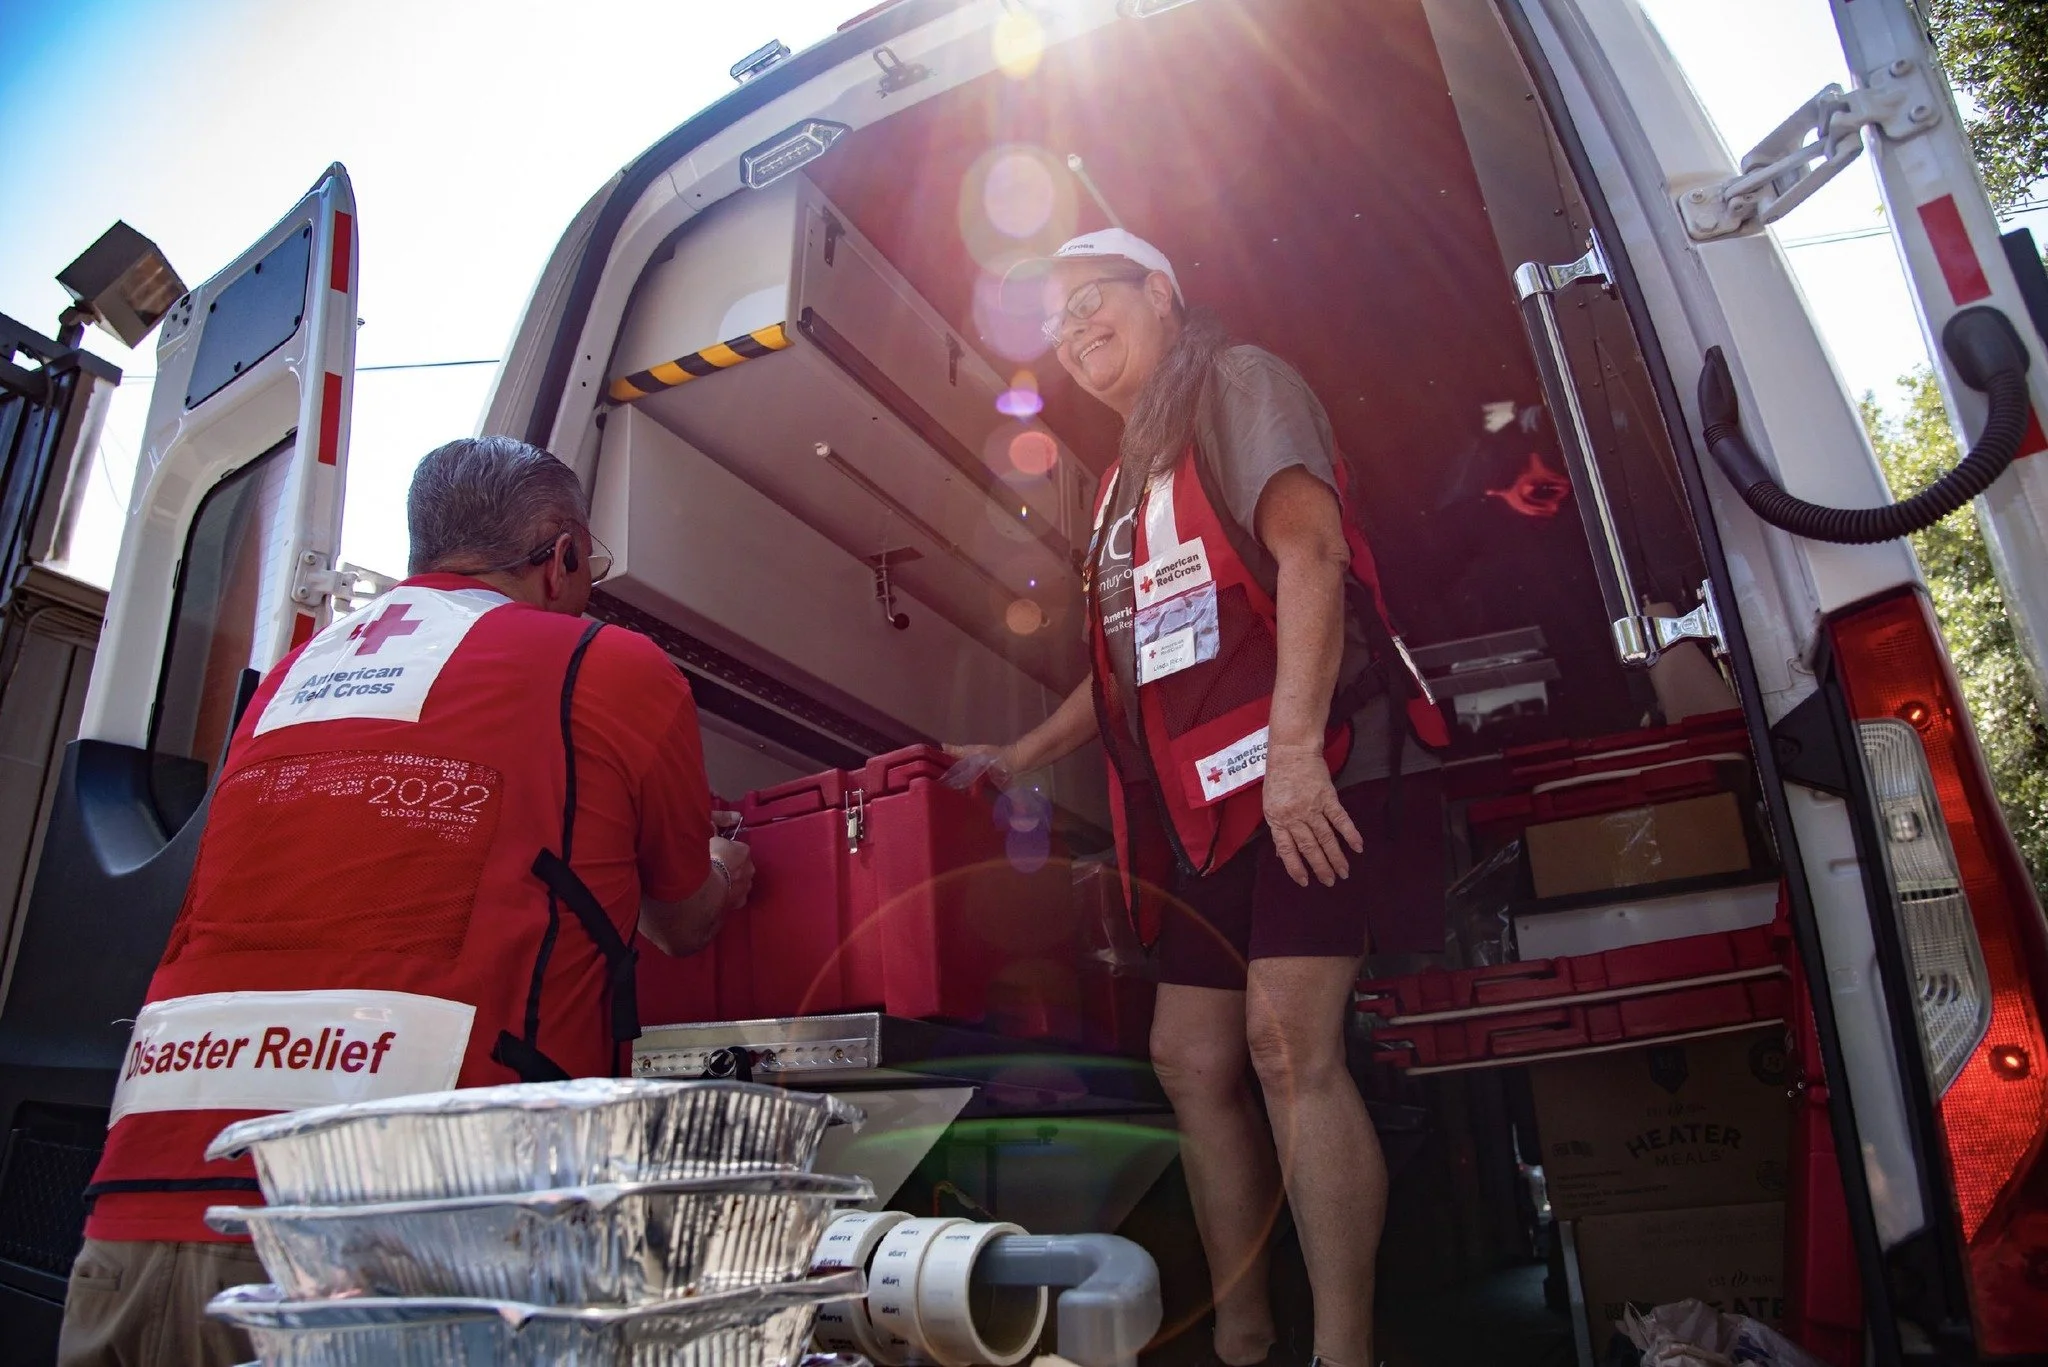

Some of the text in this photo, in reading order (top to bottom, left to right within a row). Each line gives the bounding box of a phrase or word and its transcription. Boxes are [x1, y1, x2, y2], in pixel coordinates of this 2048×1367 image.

[1154, 553, 1200, 578] American
[1156, 563, 1202, 588] Red Cross
[1103, 606, 1133, 625] Americ
[300, 666, 404, 690] American
[290, 683, 395, 705] Red Cross
[384, 754, 470, 771] HURRICANE
[1226, 742, 1269, 768] America
[1227, 753, 1268, 777] Red Cro
[442, 769, 467, 781] IAN
[368, 775, 491, 814] 2022
[380, 807, 478, 824] BLOOD DRIVES
[125, 1027, 397, 1082] Disaster Relief
[1625, 1122, 1744, 1160] HEATER
[1654, 1151, 1722, 1169] MEALS
[829, 1234, 853, 1242] X-Large
[888, 1250, 907, 1258] Large
[882, 1278, 900, 1287] Large
[882, 1305, 900, 1316] Large
